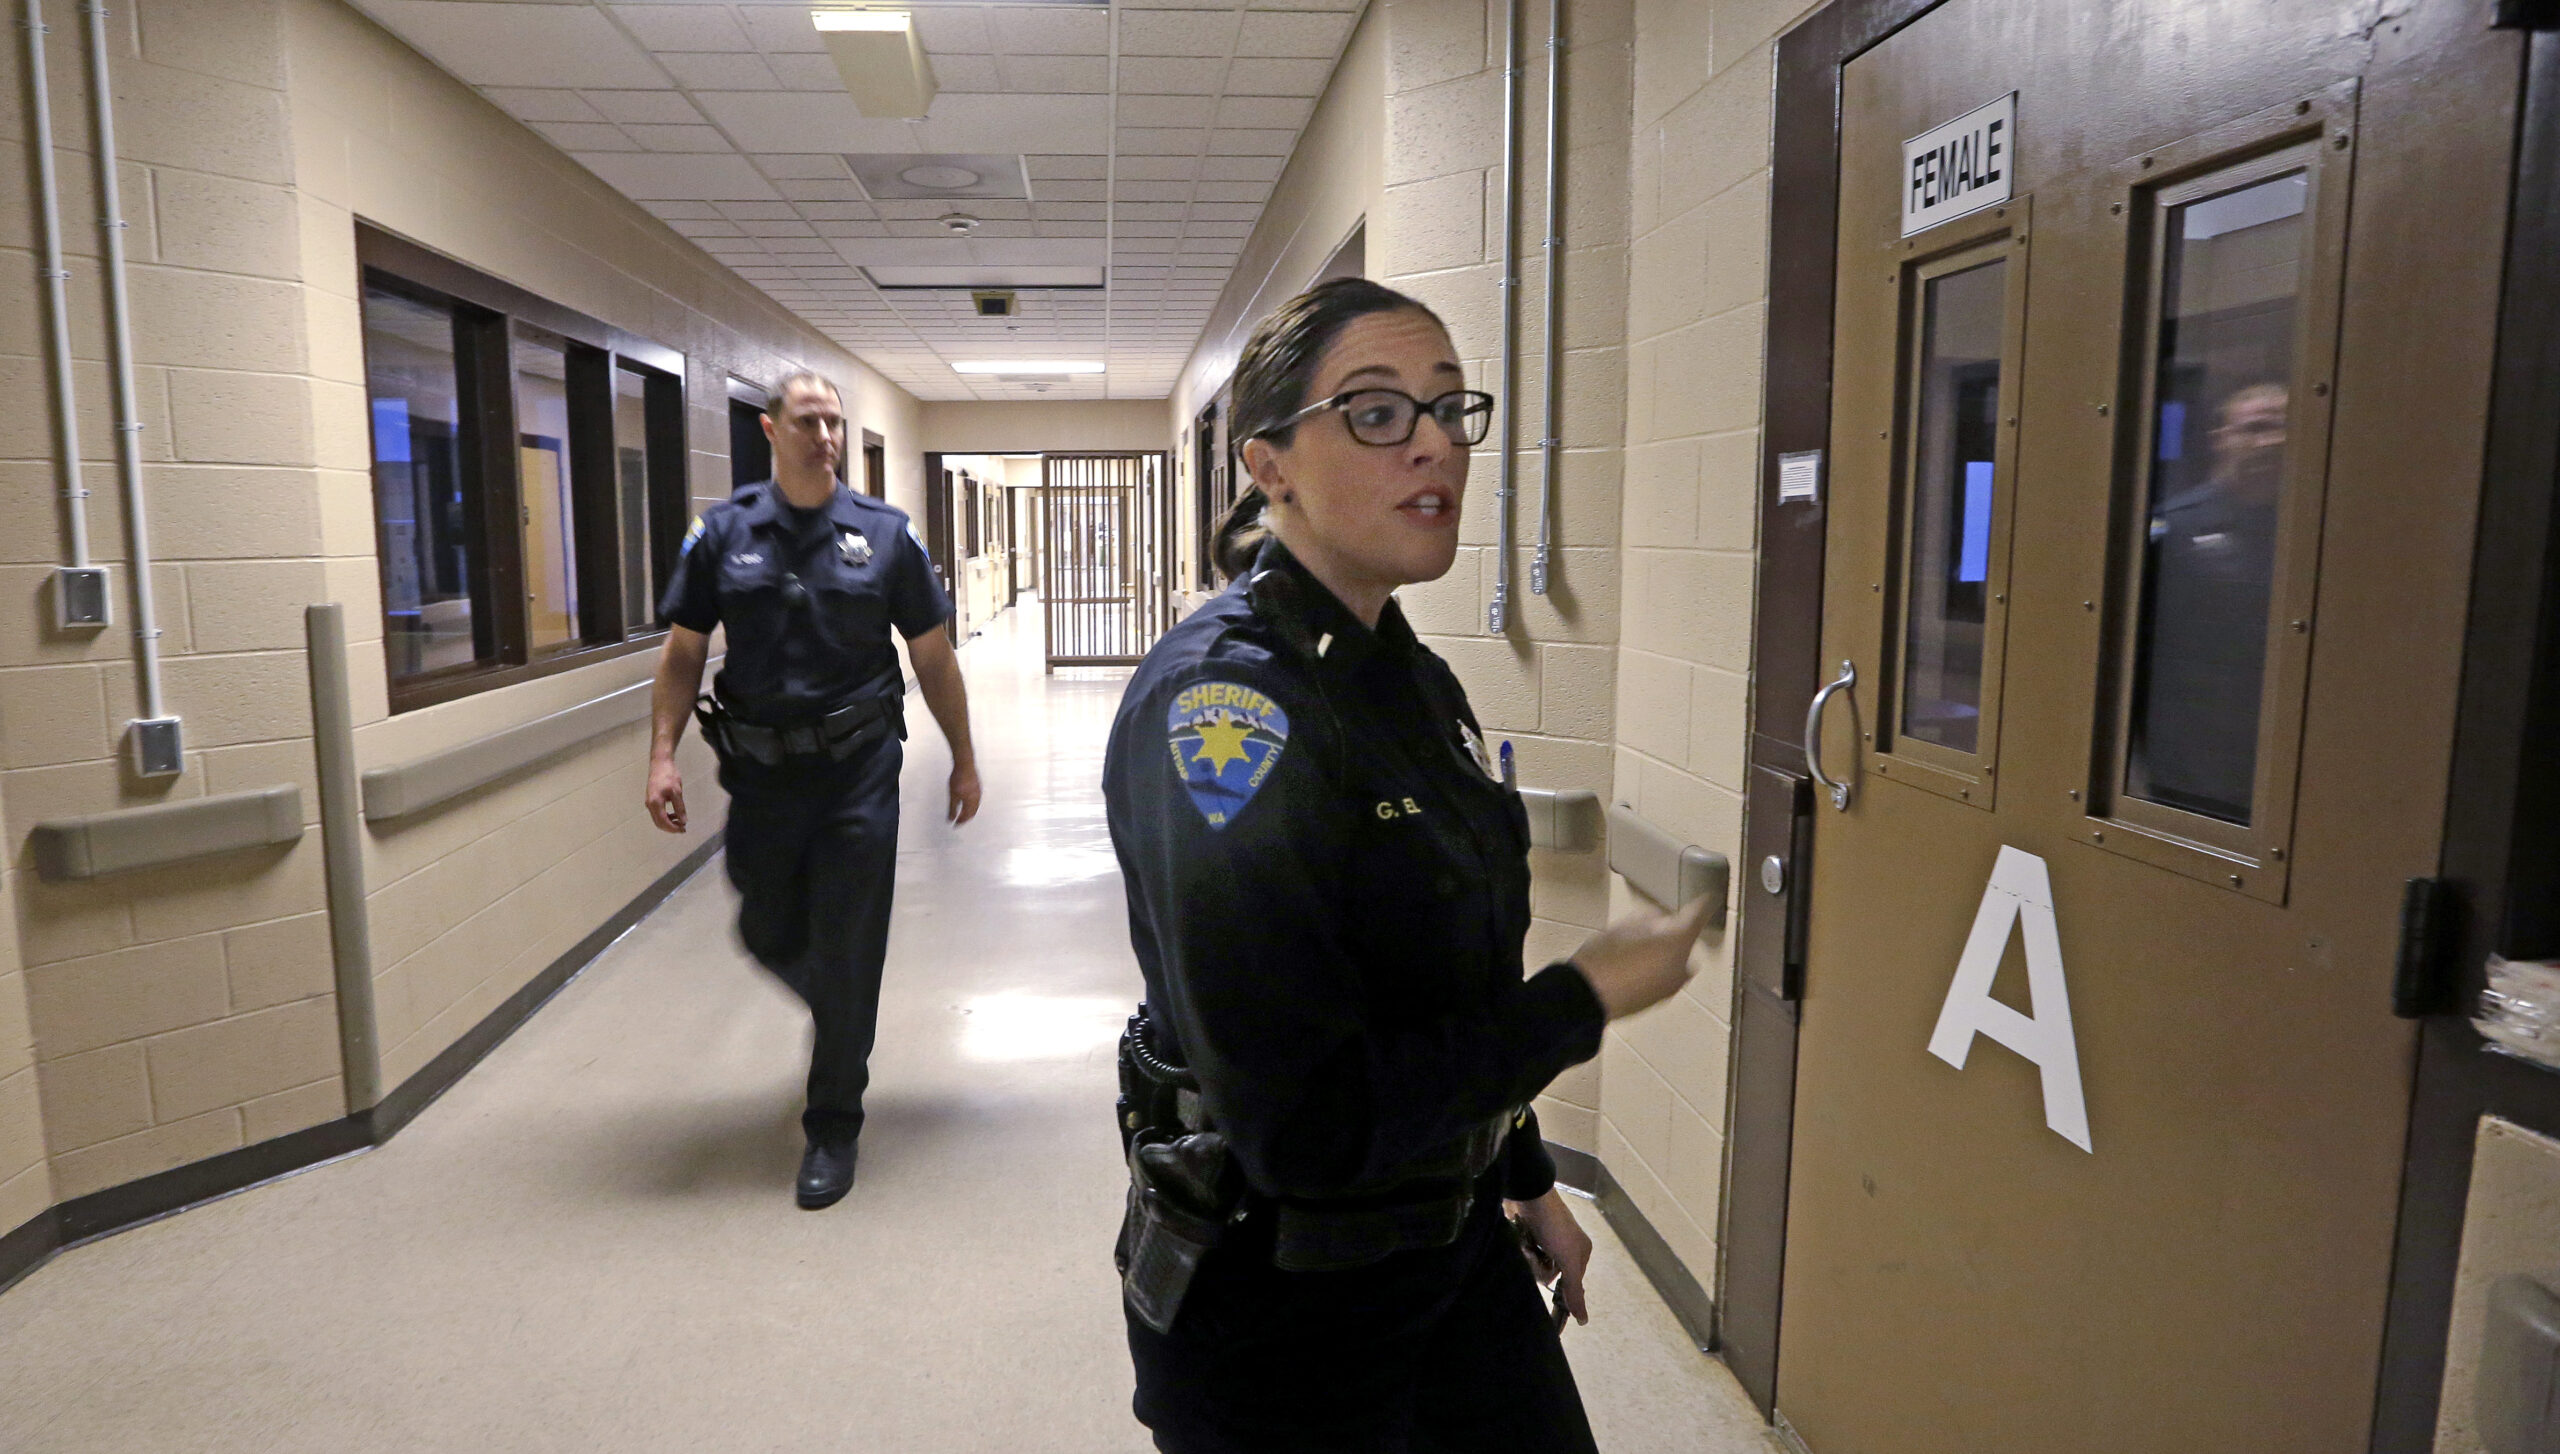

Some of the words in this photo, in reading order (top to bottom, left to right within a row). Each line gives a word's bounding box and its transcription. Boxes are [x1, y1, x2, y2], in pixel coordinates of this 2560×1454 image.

[1911, 118, 2004, 214] FEMALE
[1177, 682, 1277, 717] SHERIFF
[1248, 745, 1280, 788] COUNTY
[1926, 843, 2094, 1155] A
